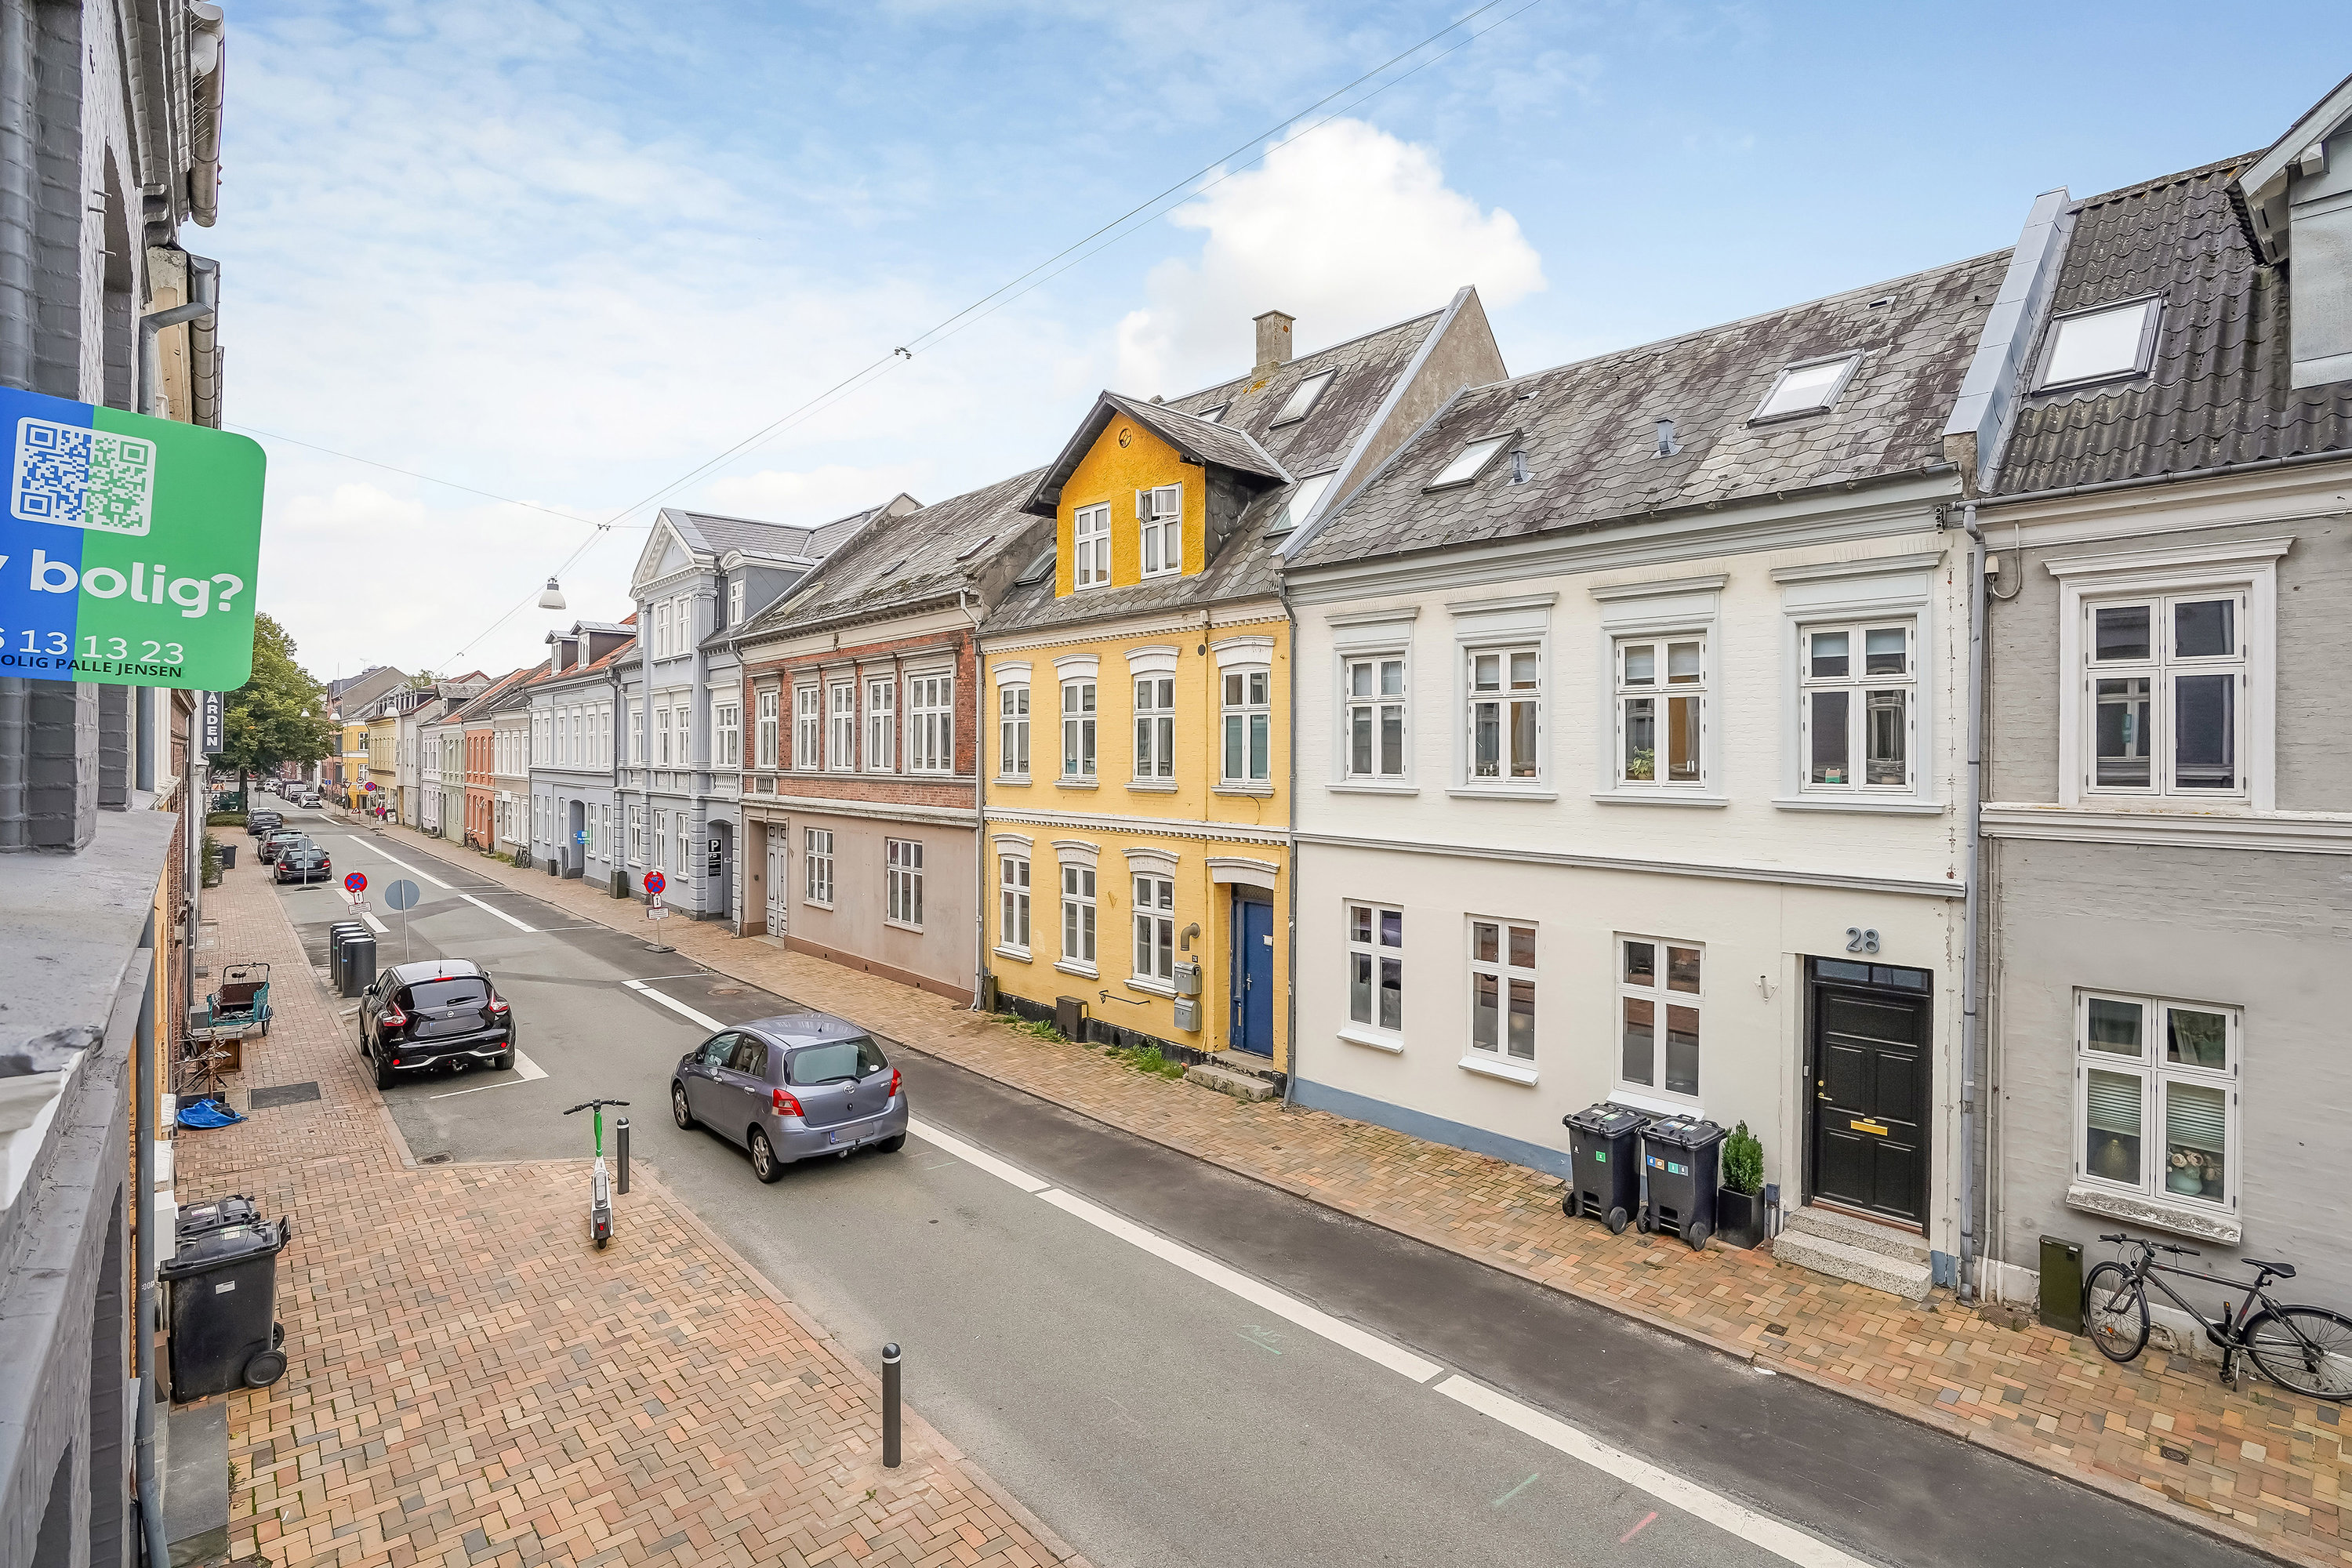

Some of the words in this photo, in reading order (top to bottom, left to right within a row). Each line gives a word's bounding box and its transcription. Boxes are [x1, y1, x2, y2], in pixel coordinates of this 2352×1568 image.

[30, 548, 244, 619] bolig?
[19, 629, 69, 655] 13
[82, 635, 128, 660] 13
[140, 640, 184, 665] 23
[1, 654, 49, 669] OLIG
[56, 658, 112, 673] PALLE
[115, 662, 182, 678] JENSEN
[1846, 927, 1881, 953] 28
